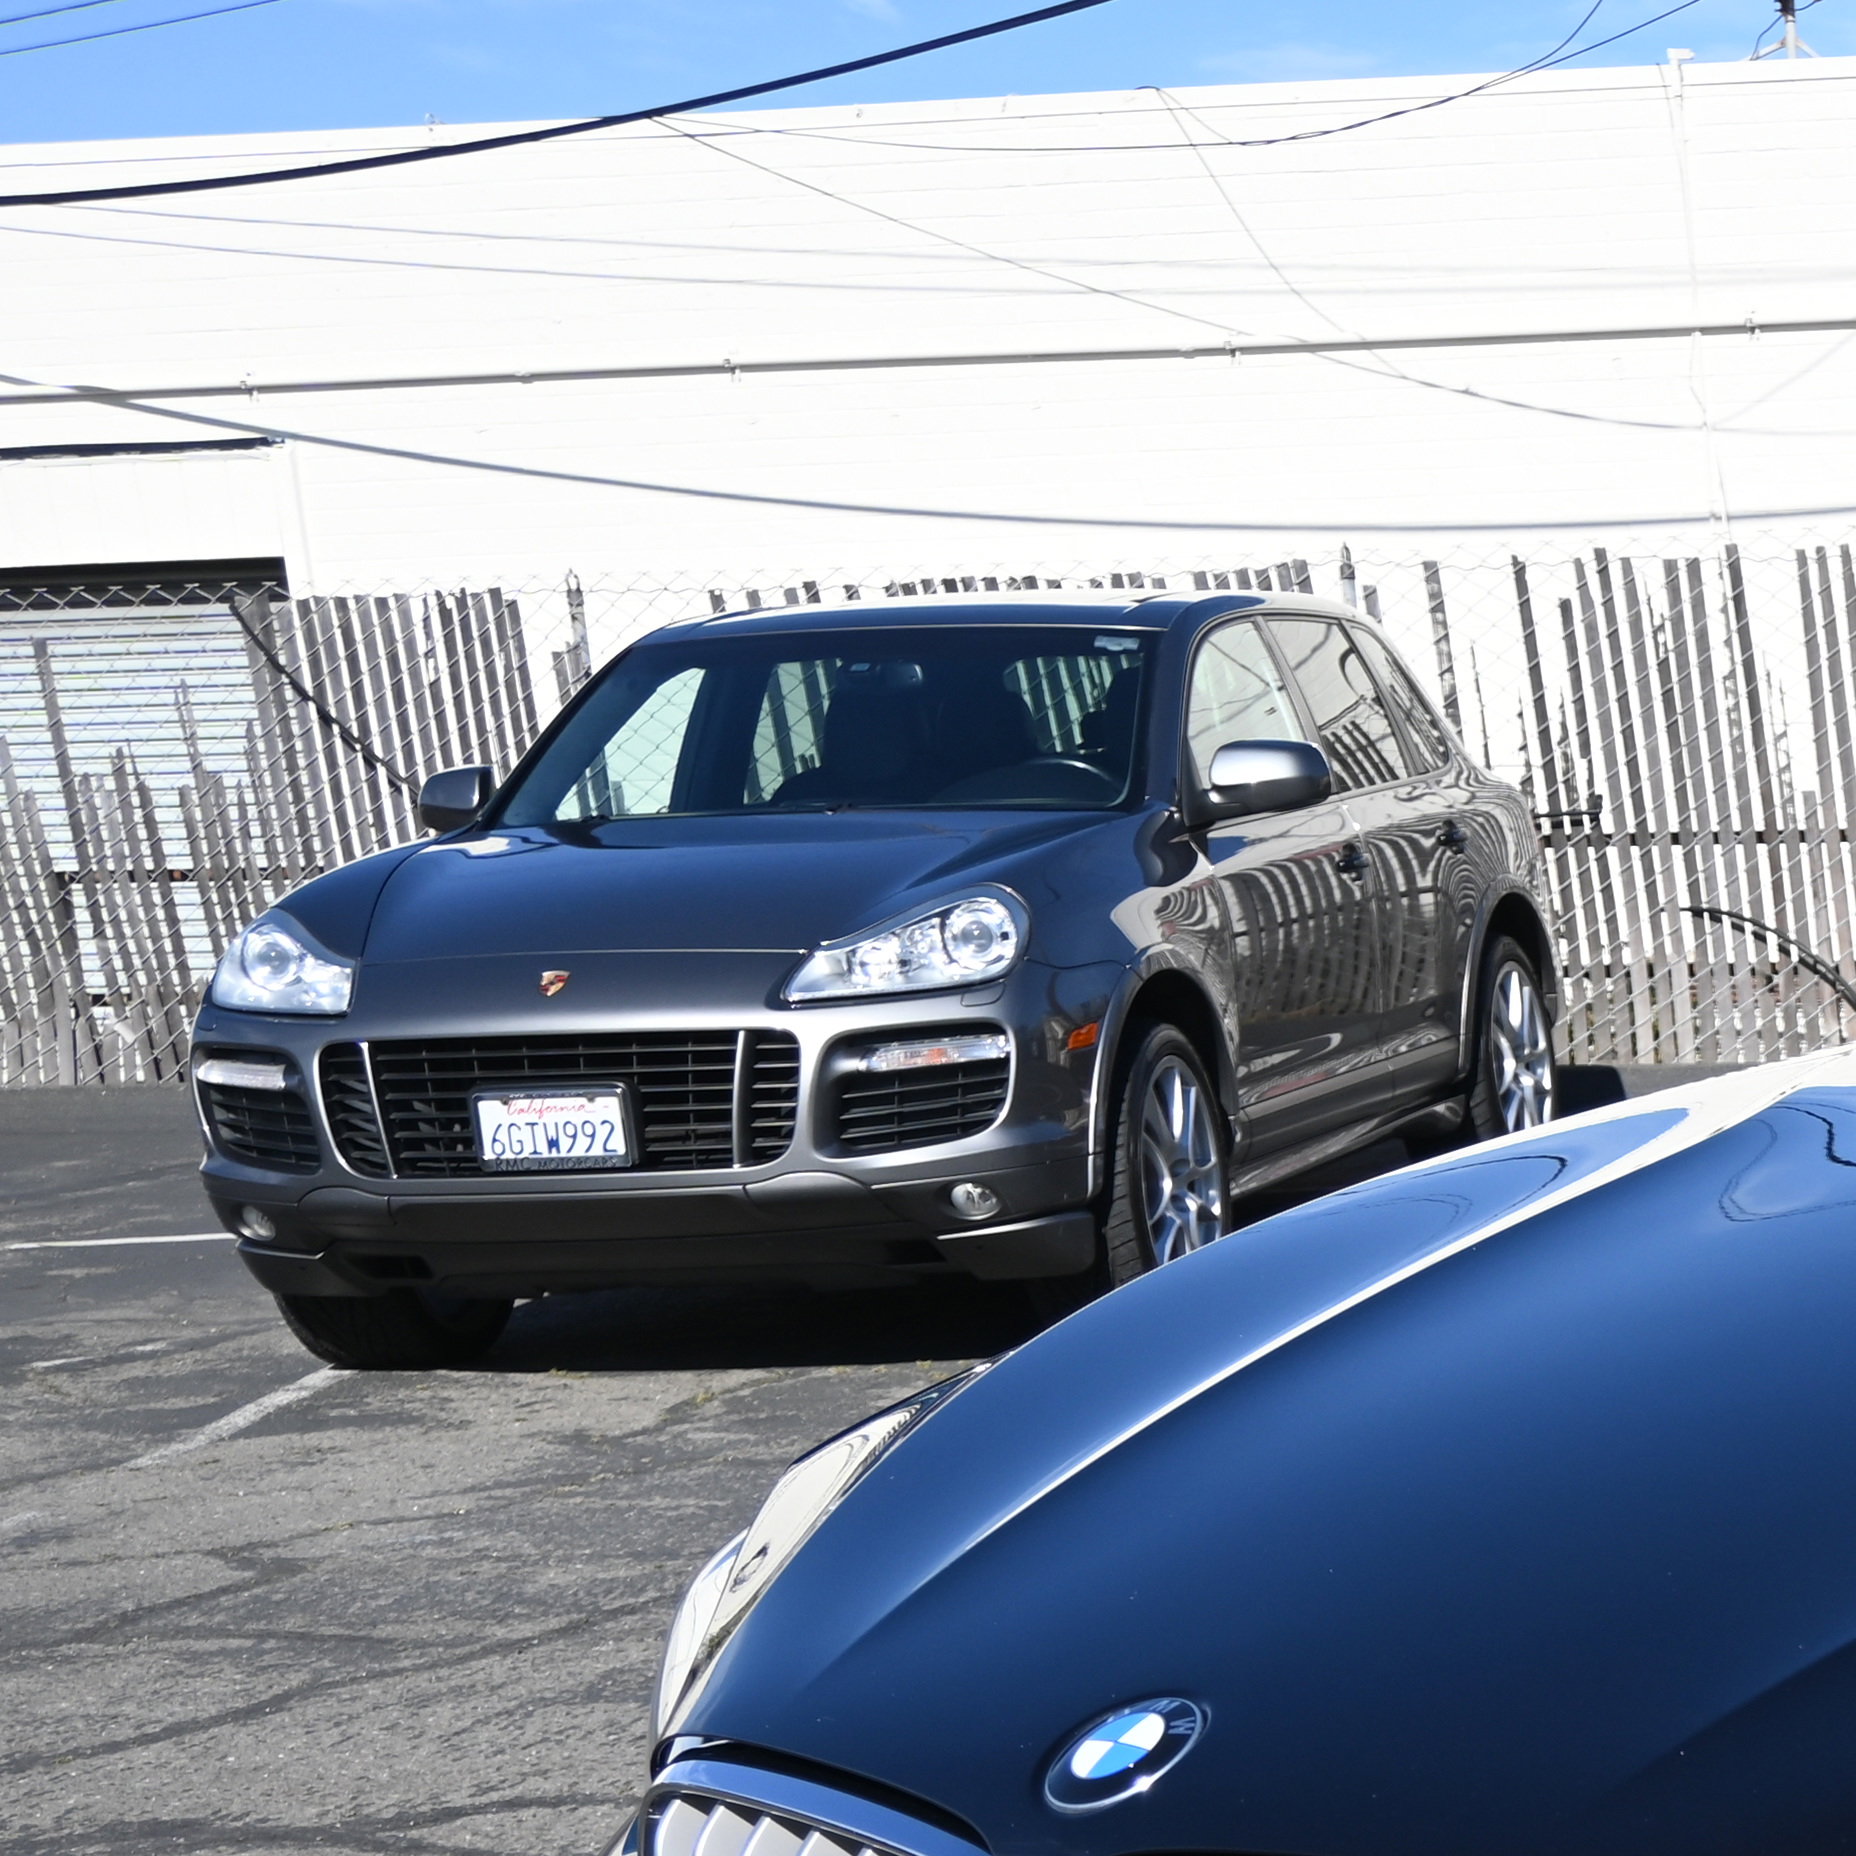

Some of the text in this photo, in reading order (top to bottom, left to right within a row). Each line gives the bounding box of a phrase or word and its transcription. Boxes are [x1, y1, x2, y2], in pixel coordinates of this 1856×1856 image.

[506, 1099, 597, 1119] California
[491, 1119, 618, 1156] 6GIW992
[495, 1157, 618, 1172] RMC MOTORCARS
